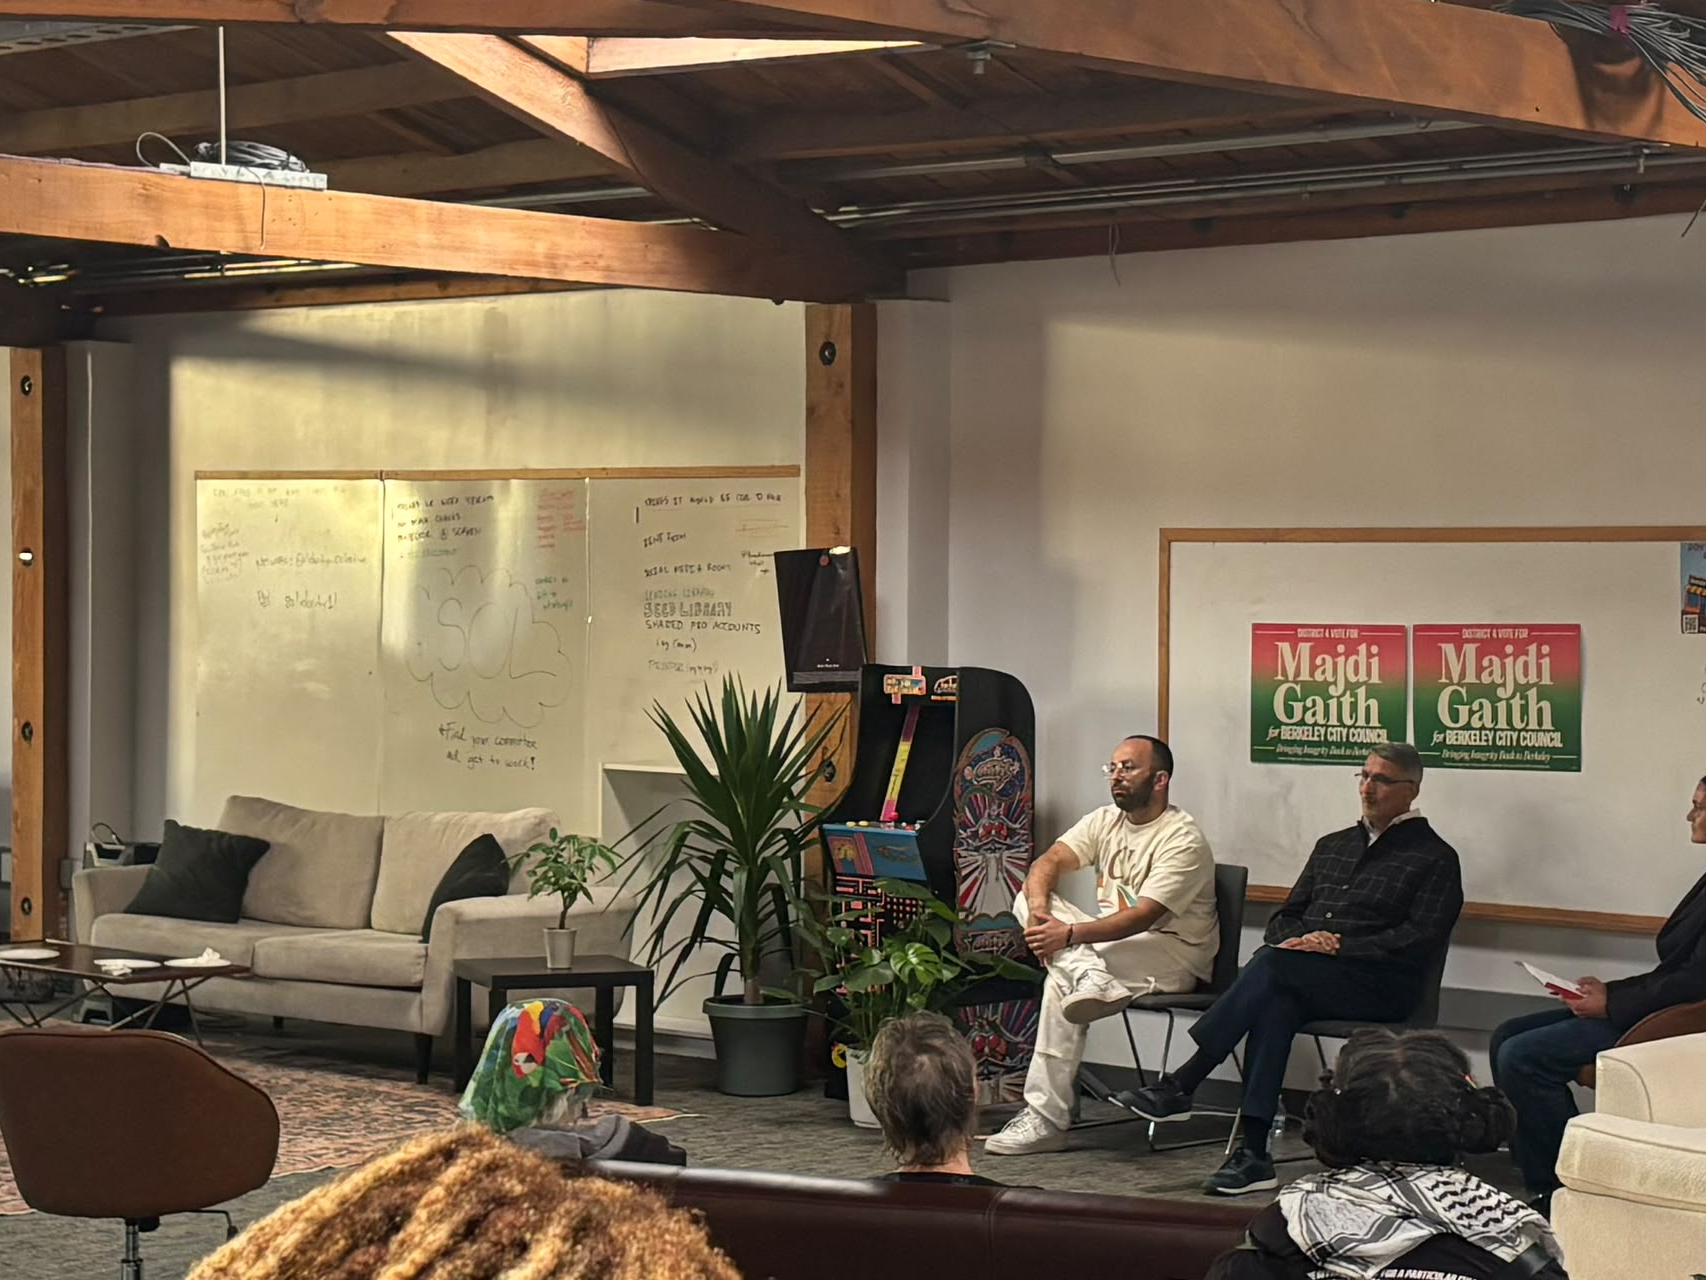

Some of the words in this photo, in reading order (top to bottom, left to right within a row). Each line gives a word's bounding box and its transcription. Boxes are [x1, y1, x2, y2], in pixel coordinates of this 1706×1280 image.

[680, 601, 732, 618] LIBRARY
[1273, 641, 1382, 696] Majdi
[1437, 642, 1554, 698] Majdi
[1273, 682, 1382, 728] Gaith
[1437, 684, 1555, 730] Gaith
[1281, 726, 1324, 741] BERKELEY
[1327, 726, 1348, 742] CITY
[1349, 728, 1390, 744] COUNCIL
[1430, 730, 1446, 746] for
[1446, 730, 1494, 746] BERKELEY
[1496, 730, 1518, 746] CITY
[1520, 731, 1564, 748] COUNCIL
